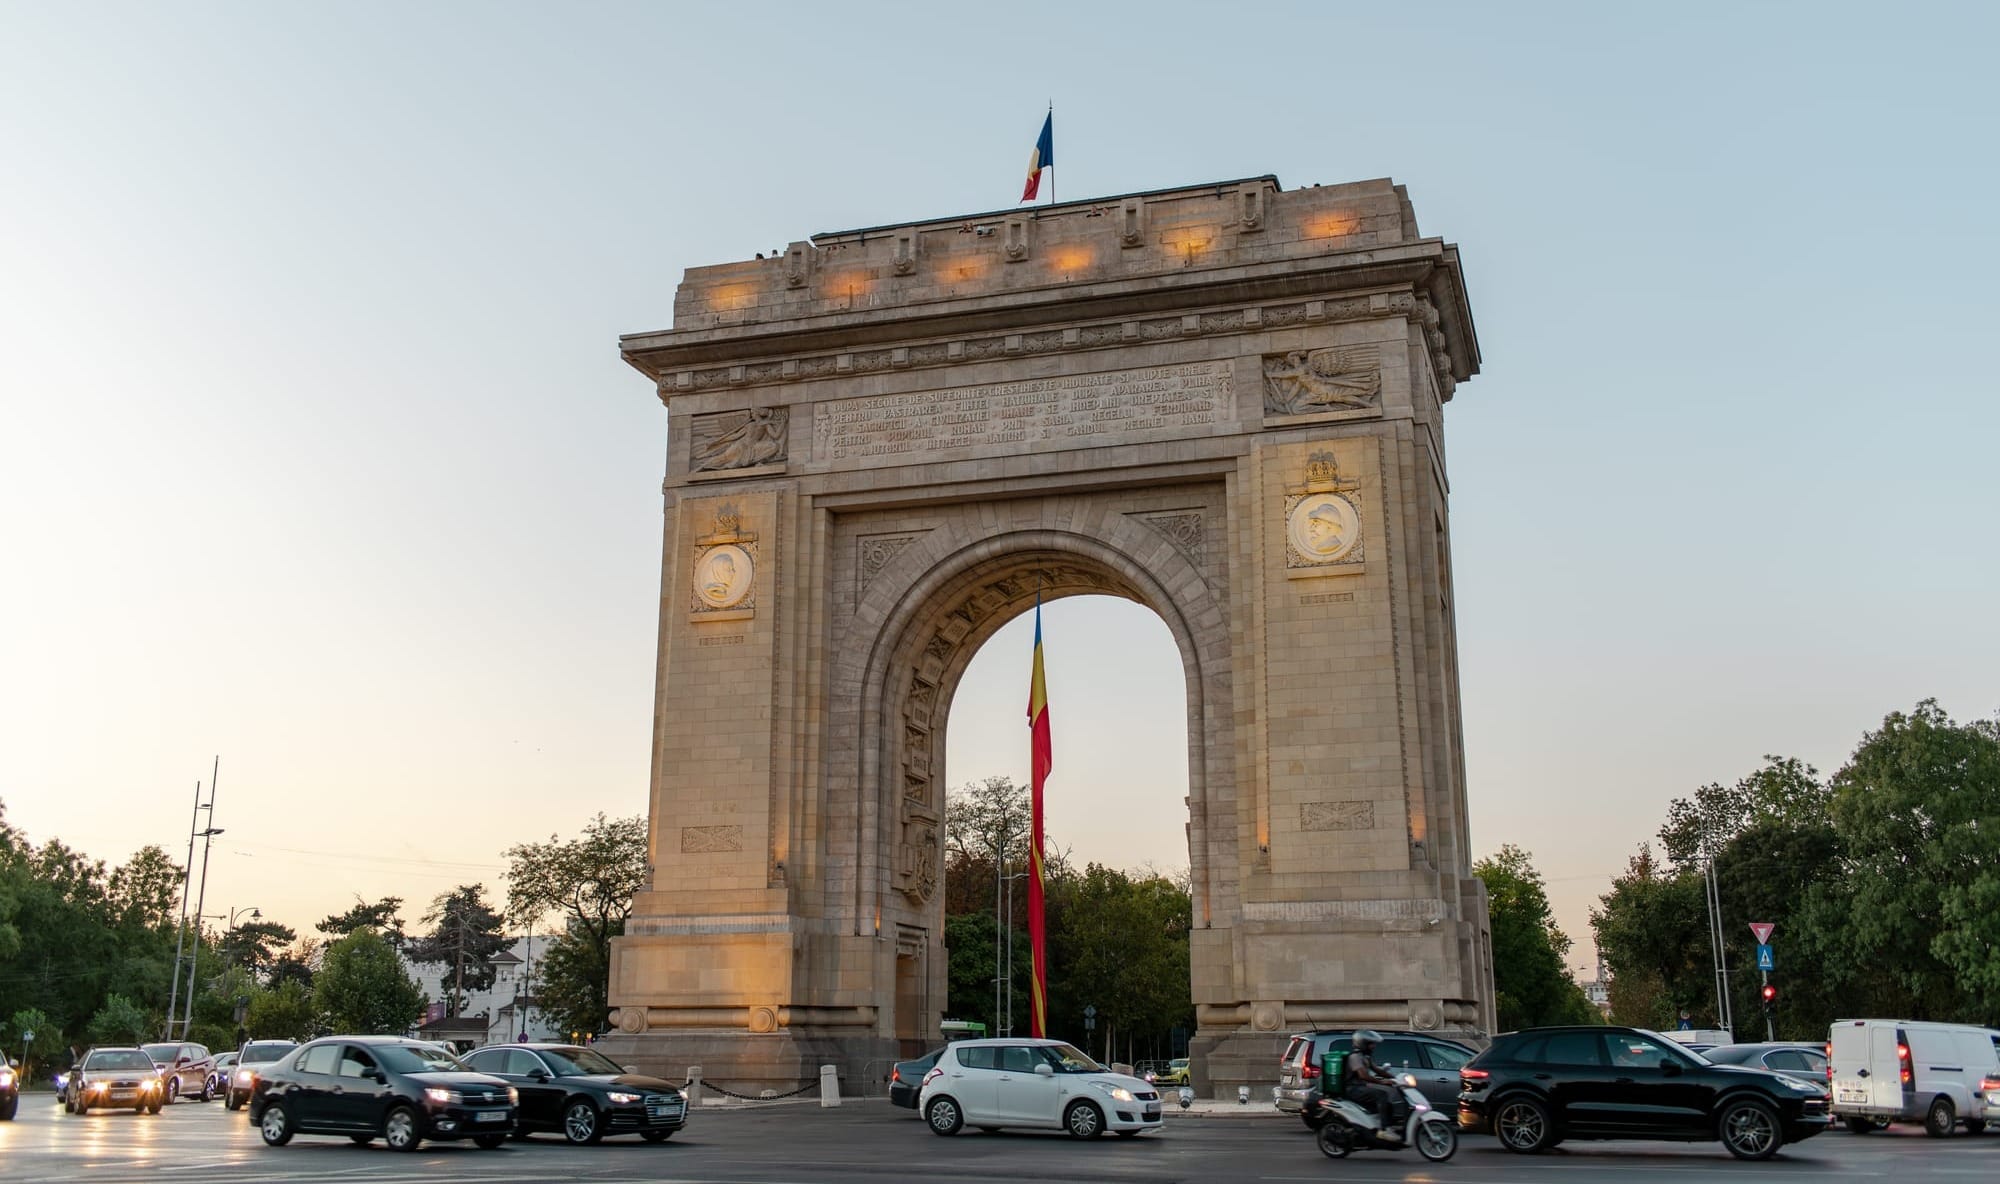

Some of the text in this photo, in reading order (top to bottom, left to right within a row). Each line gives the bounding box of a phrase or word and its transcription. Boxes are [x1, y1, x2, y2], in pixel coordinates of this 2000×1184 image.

[832, 412, 872, 424] PENTRU
[884, 405, 942, 419] PASTRAREA
[1001, 392, 1059, 407] NATIONALE
[1072, 388, 1098, 400] DUPA
[1111, 382, 1167, 396] APARAREA
[1181, 376, 1213, 389] PLINA
[832, 425, 846, 435] DE
[856, 419, 905, 433] SACRIFICII
[915, 417, 922, 427] A
[1046, 404, 1058, 414] SE
[1131, 390, 1192, 406] DREPTATEA
[1202, 389, 1213, 399] SI
[834, 401, 859, 412] DUPA
[864, 397, 903, 409] SECOLE
[909, 394, 922, 404] DE
[928, 388, 984, 402] SUFERINTE
[1063, 375, 1112, 389] INDURATE
[1120, 373, 1129, 383] SI
[1137, 368, 1170, 382] LUPTE
[1178, 365, 1212, 378] GRELE
[832, 400, 1213, 447] PENTRU POPORUL ROMAN PRIN SABIA REGELUI FERDINAND
[832, 448, 846, 459] CU
[861, 441, 912, 456] AJUTORUL
[1066, 422, 1106, 437] GANDUL
[1124, 417, 1164, 431] REGINEI
[1181, 412, 1215, 425] MARIA
